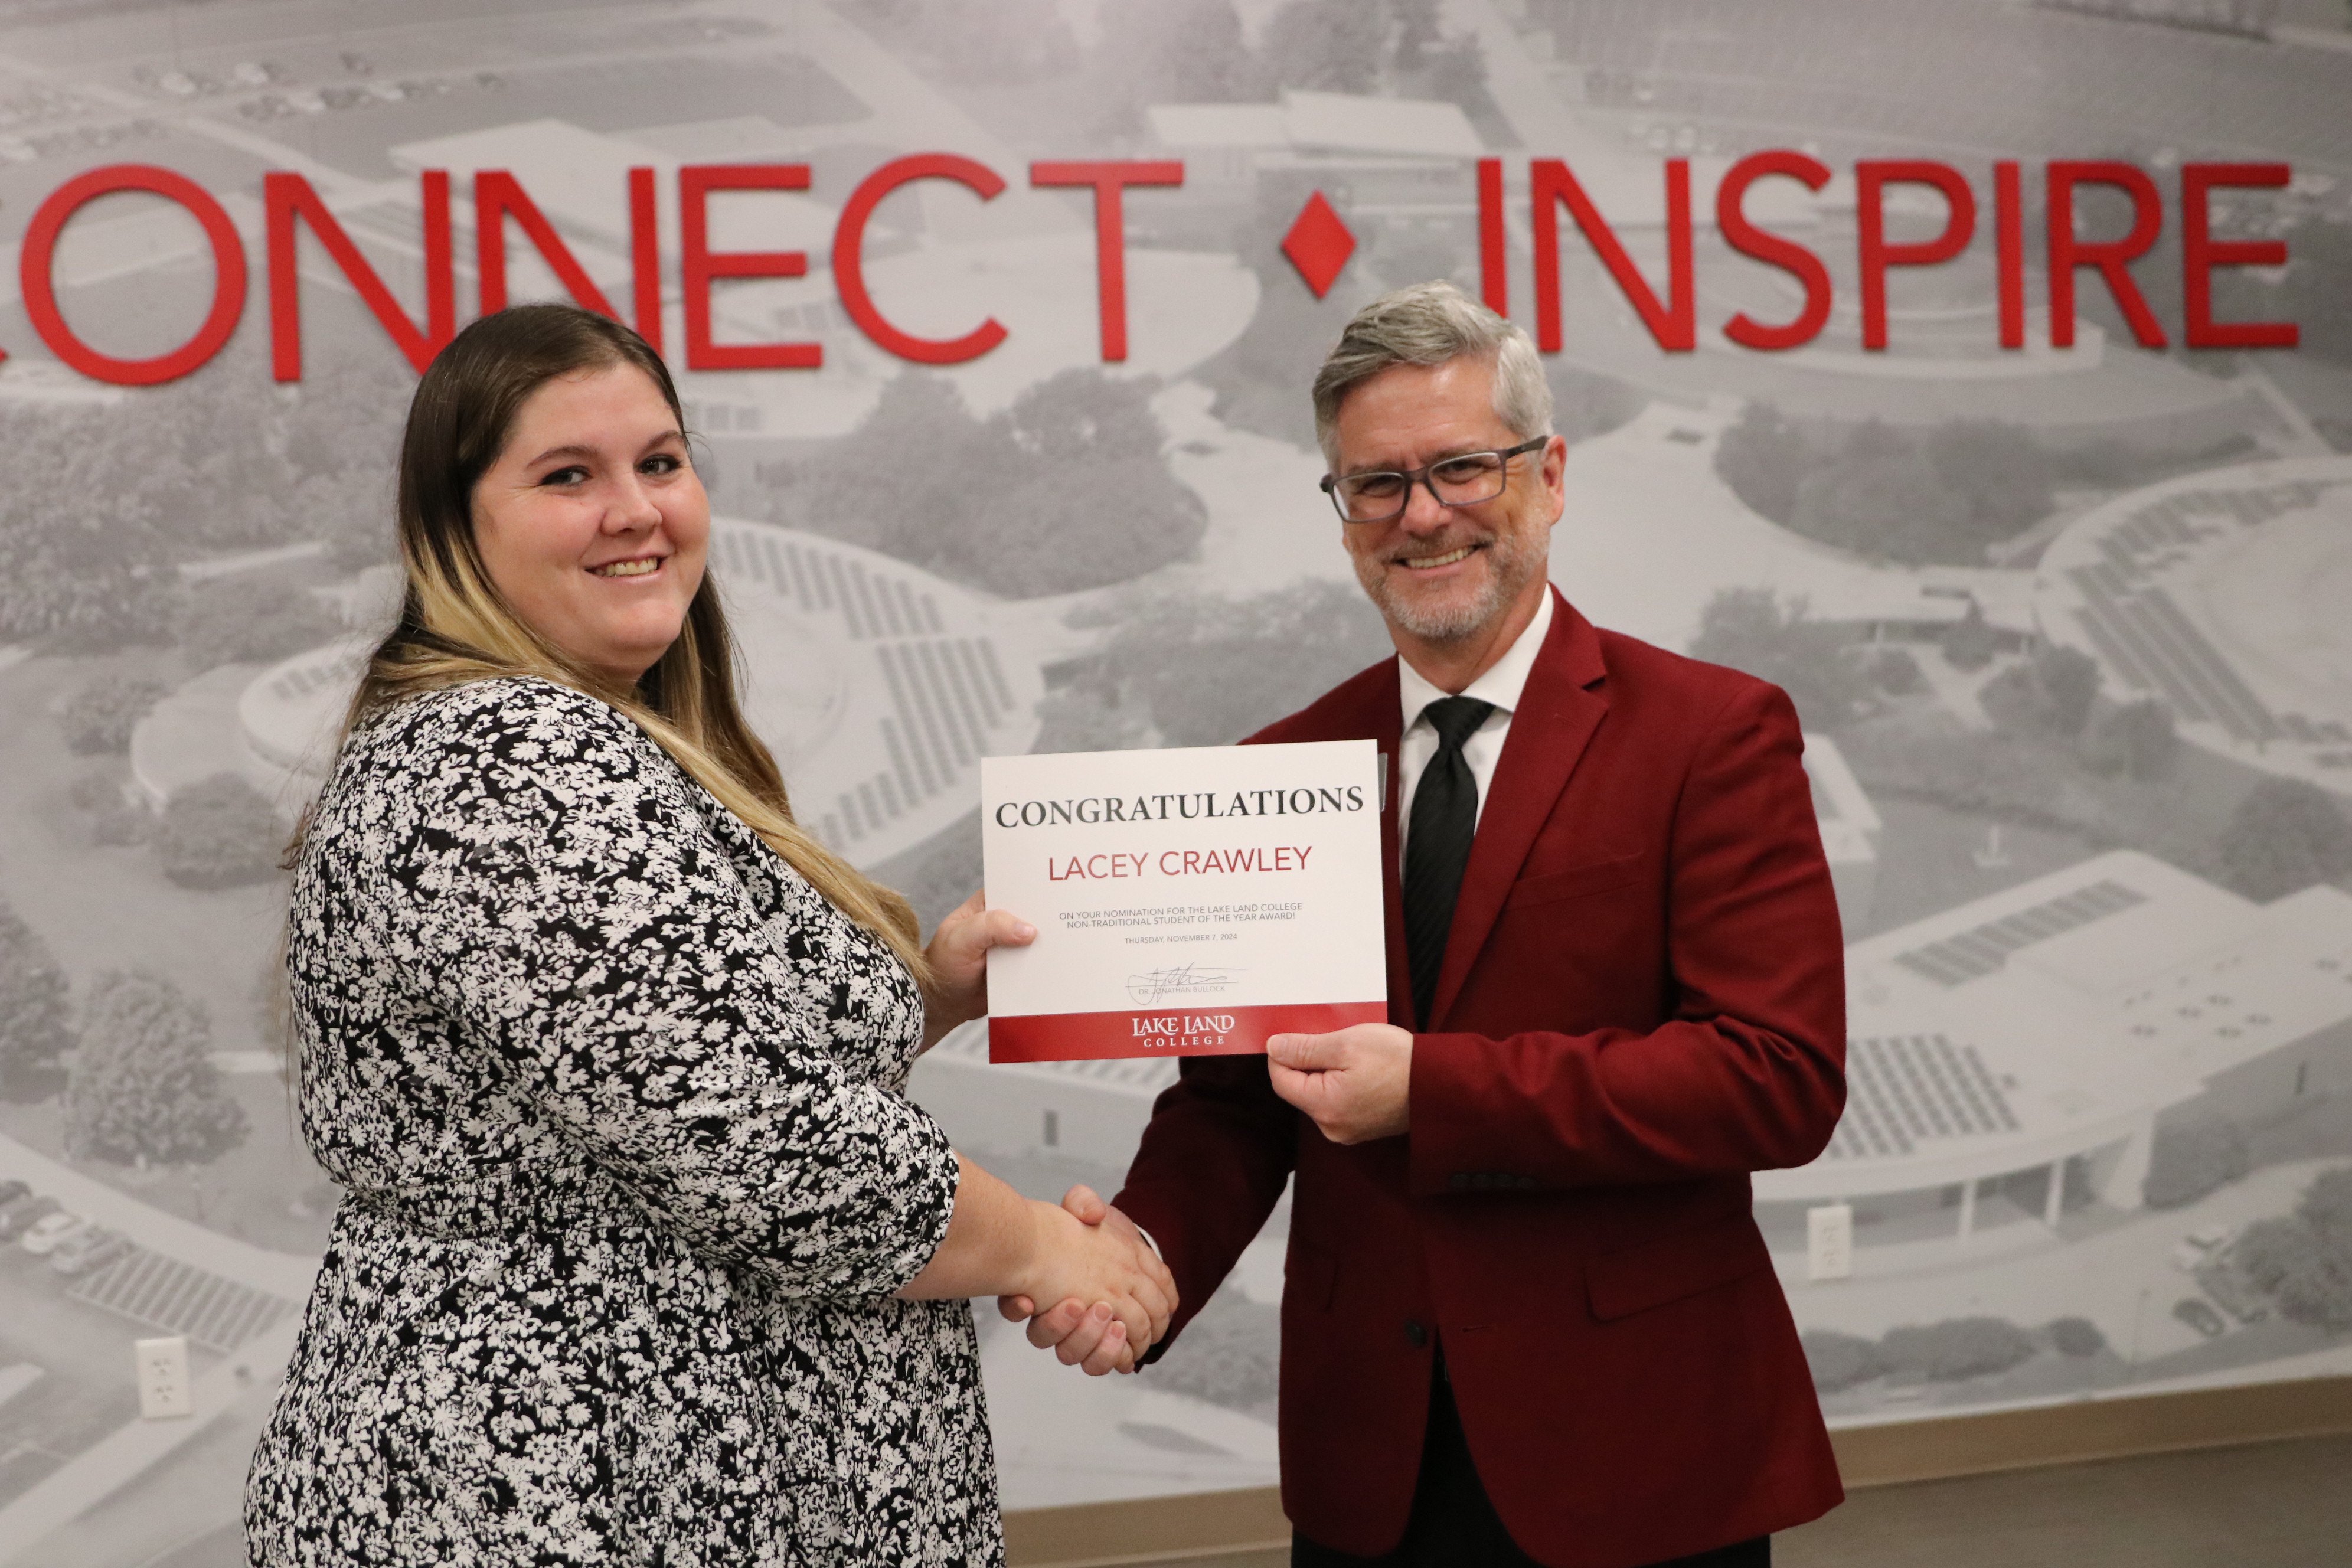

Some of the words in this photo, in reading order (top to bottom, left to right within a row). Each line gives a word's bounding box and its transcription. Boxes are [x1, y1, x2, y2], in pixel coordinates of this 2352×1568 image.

[0, 151, 1184, 386] ONNECT
[1476, 149, 2299, 354] INSPIRE
[995, 785, 1364, 828] CONGRATULATIONS
[1048, 852, 1149, 882] LACEY
[1159, 846, 1314, 876] CRAWLEY
[1067, 917, 1152, 929] NON-TRADITIONAL
[1154, 916, 1195, 925] STUDENT
[1214, 914, 1231, 922] THE
[1233, 913, 1257, 921] YEAR
[1259, 912, 1295, 920] AWARD!
[1076, 911, 1101, 919] YOUR
[1103, 908, 1164, 918] NOMINATION
[1167, 907, 1185, 915] FOR
[1188, 906, 1206, 914] THE
[1208, 905, 1230, 913] LAKE
[1233, 904, 1258, 912] LAND
[1260, 903, 1303, 912] COLLEGE
[1125, 936, 1165, 945] THURSDAY,
[1132, 1017, 1178, 1036] LAKE
[1184, 1015, 1235, 1034] LAND
[1144, 1036, 1224, 1047] COLLEGE
